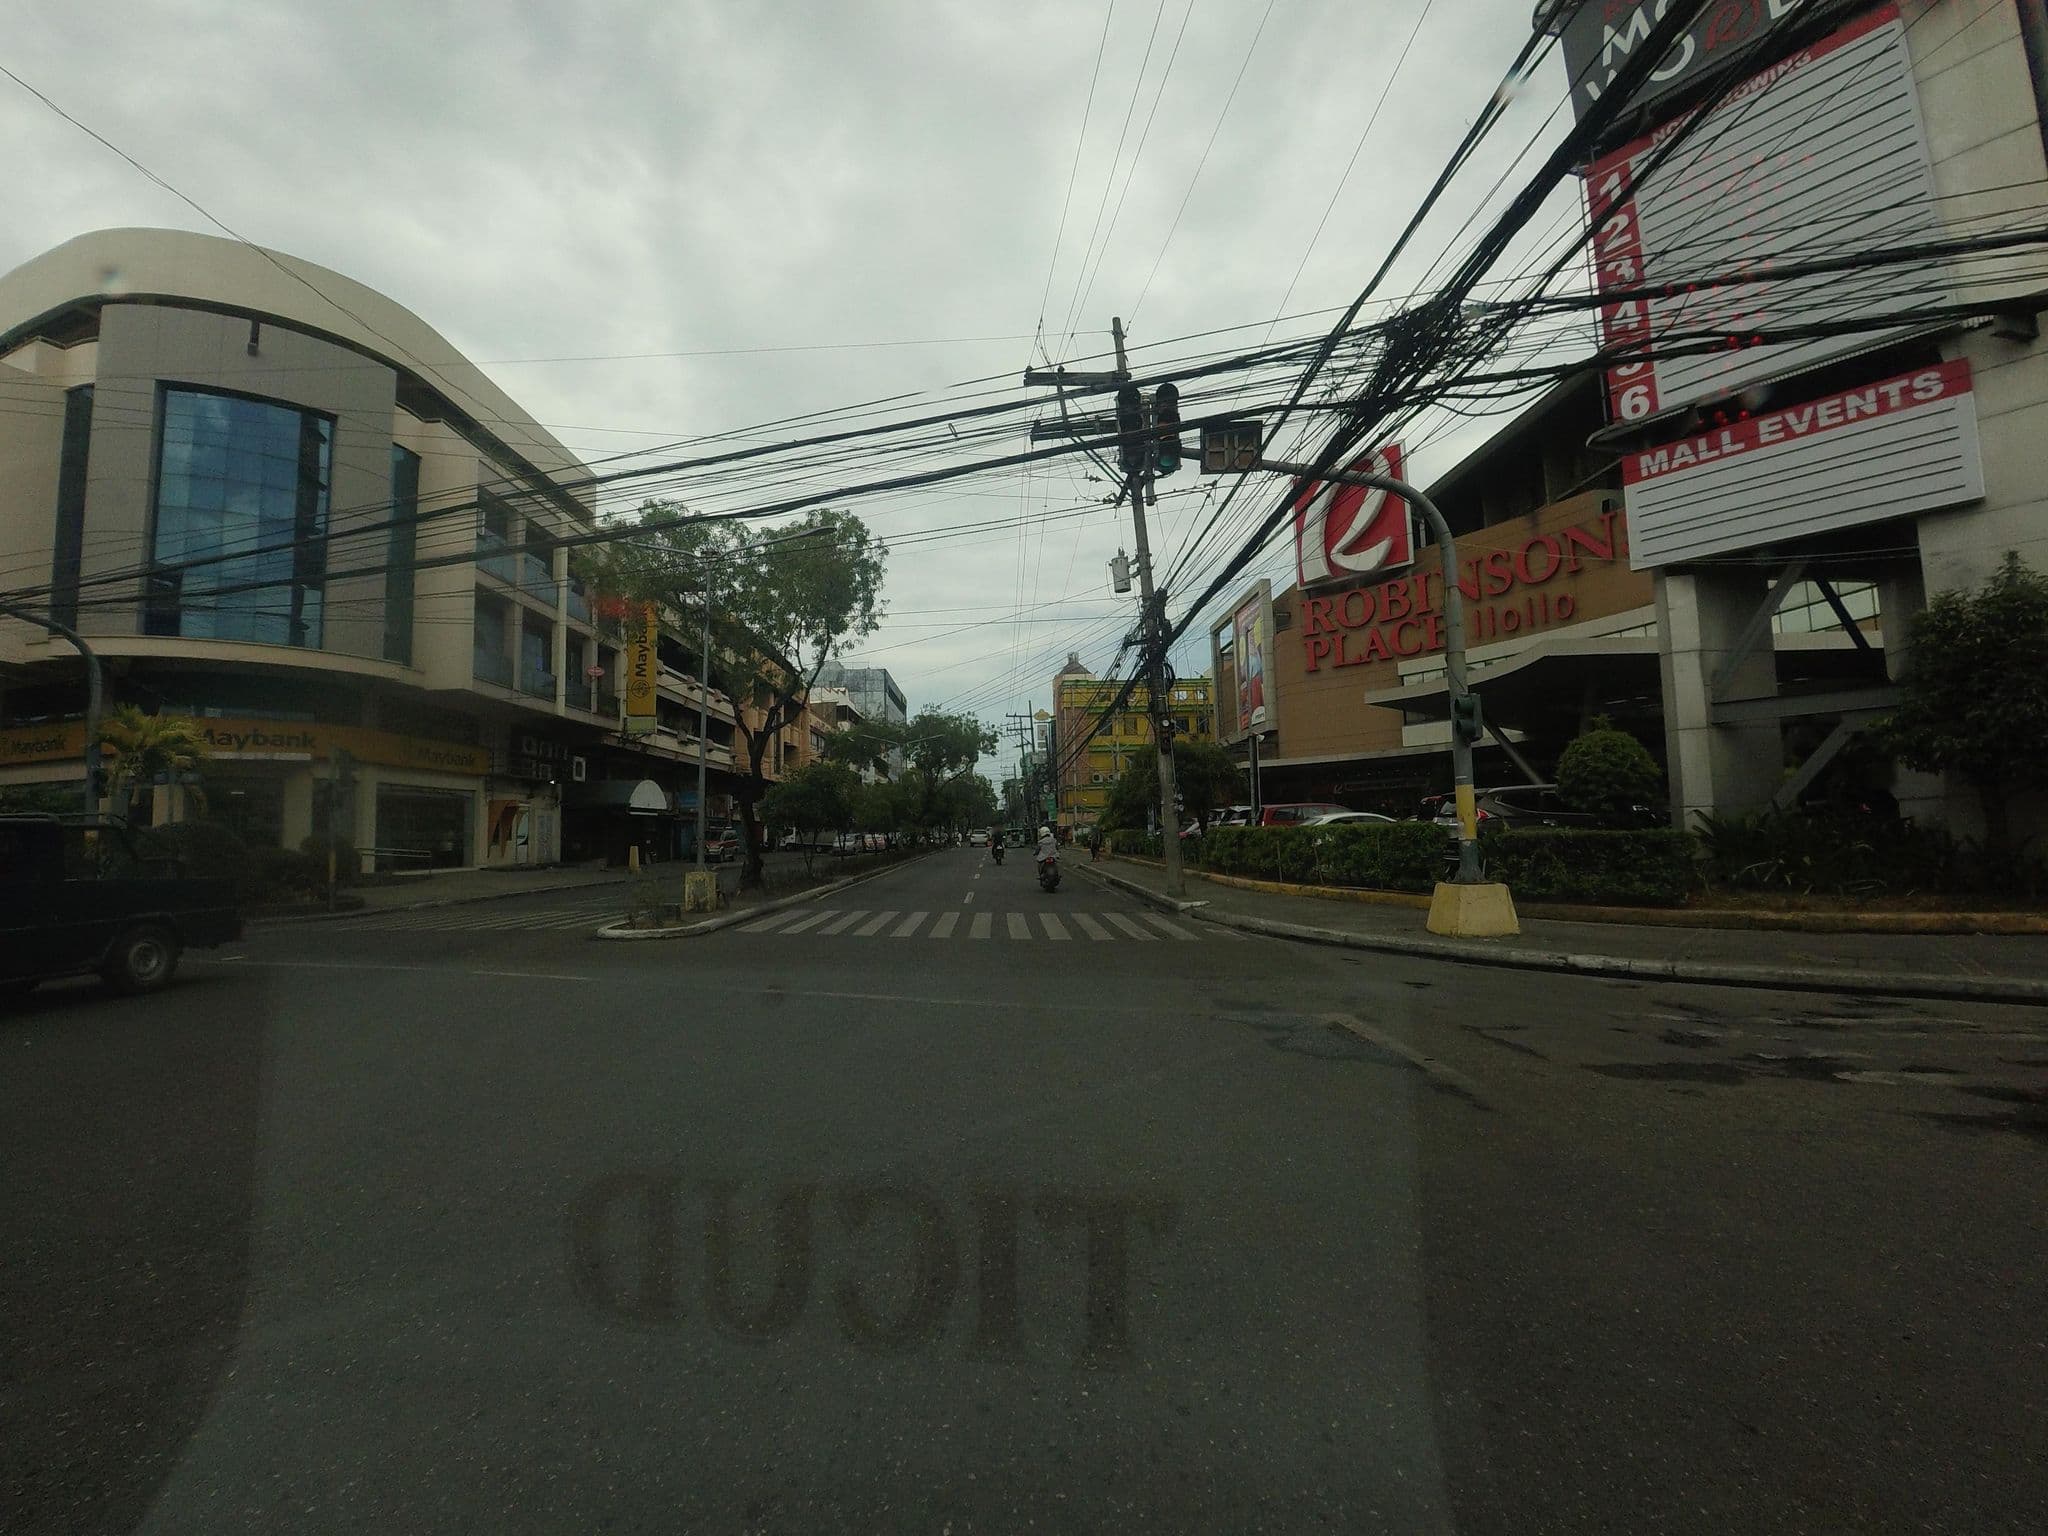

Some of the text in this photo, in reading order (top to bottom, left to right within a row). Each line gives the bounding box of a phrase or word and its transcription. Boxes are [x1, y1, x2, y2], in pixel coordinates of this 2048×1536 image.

[1600, 171, 1624, 202] 1
[1602, 213, 1632, 253] 2
[1621, 385, 1650, 421] 6
[1639, 369, 1946, 478] MALL EVENTS
[1301, 511, 1629, 637] ROBINSON
